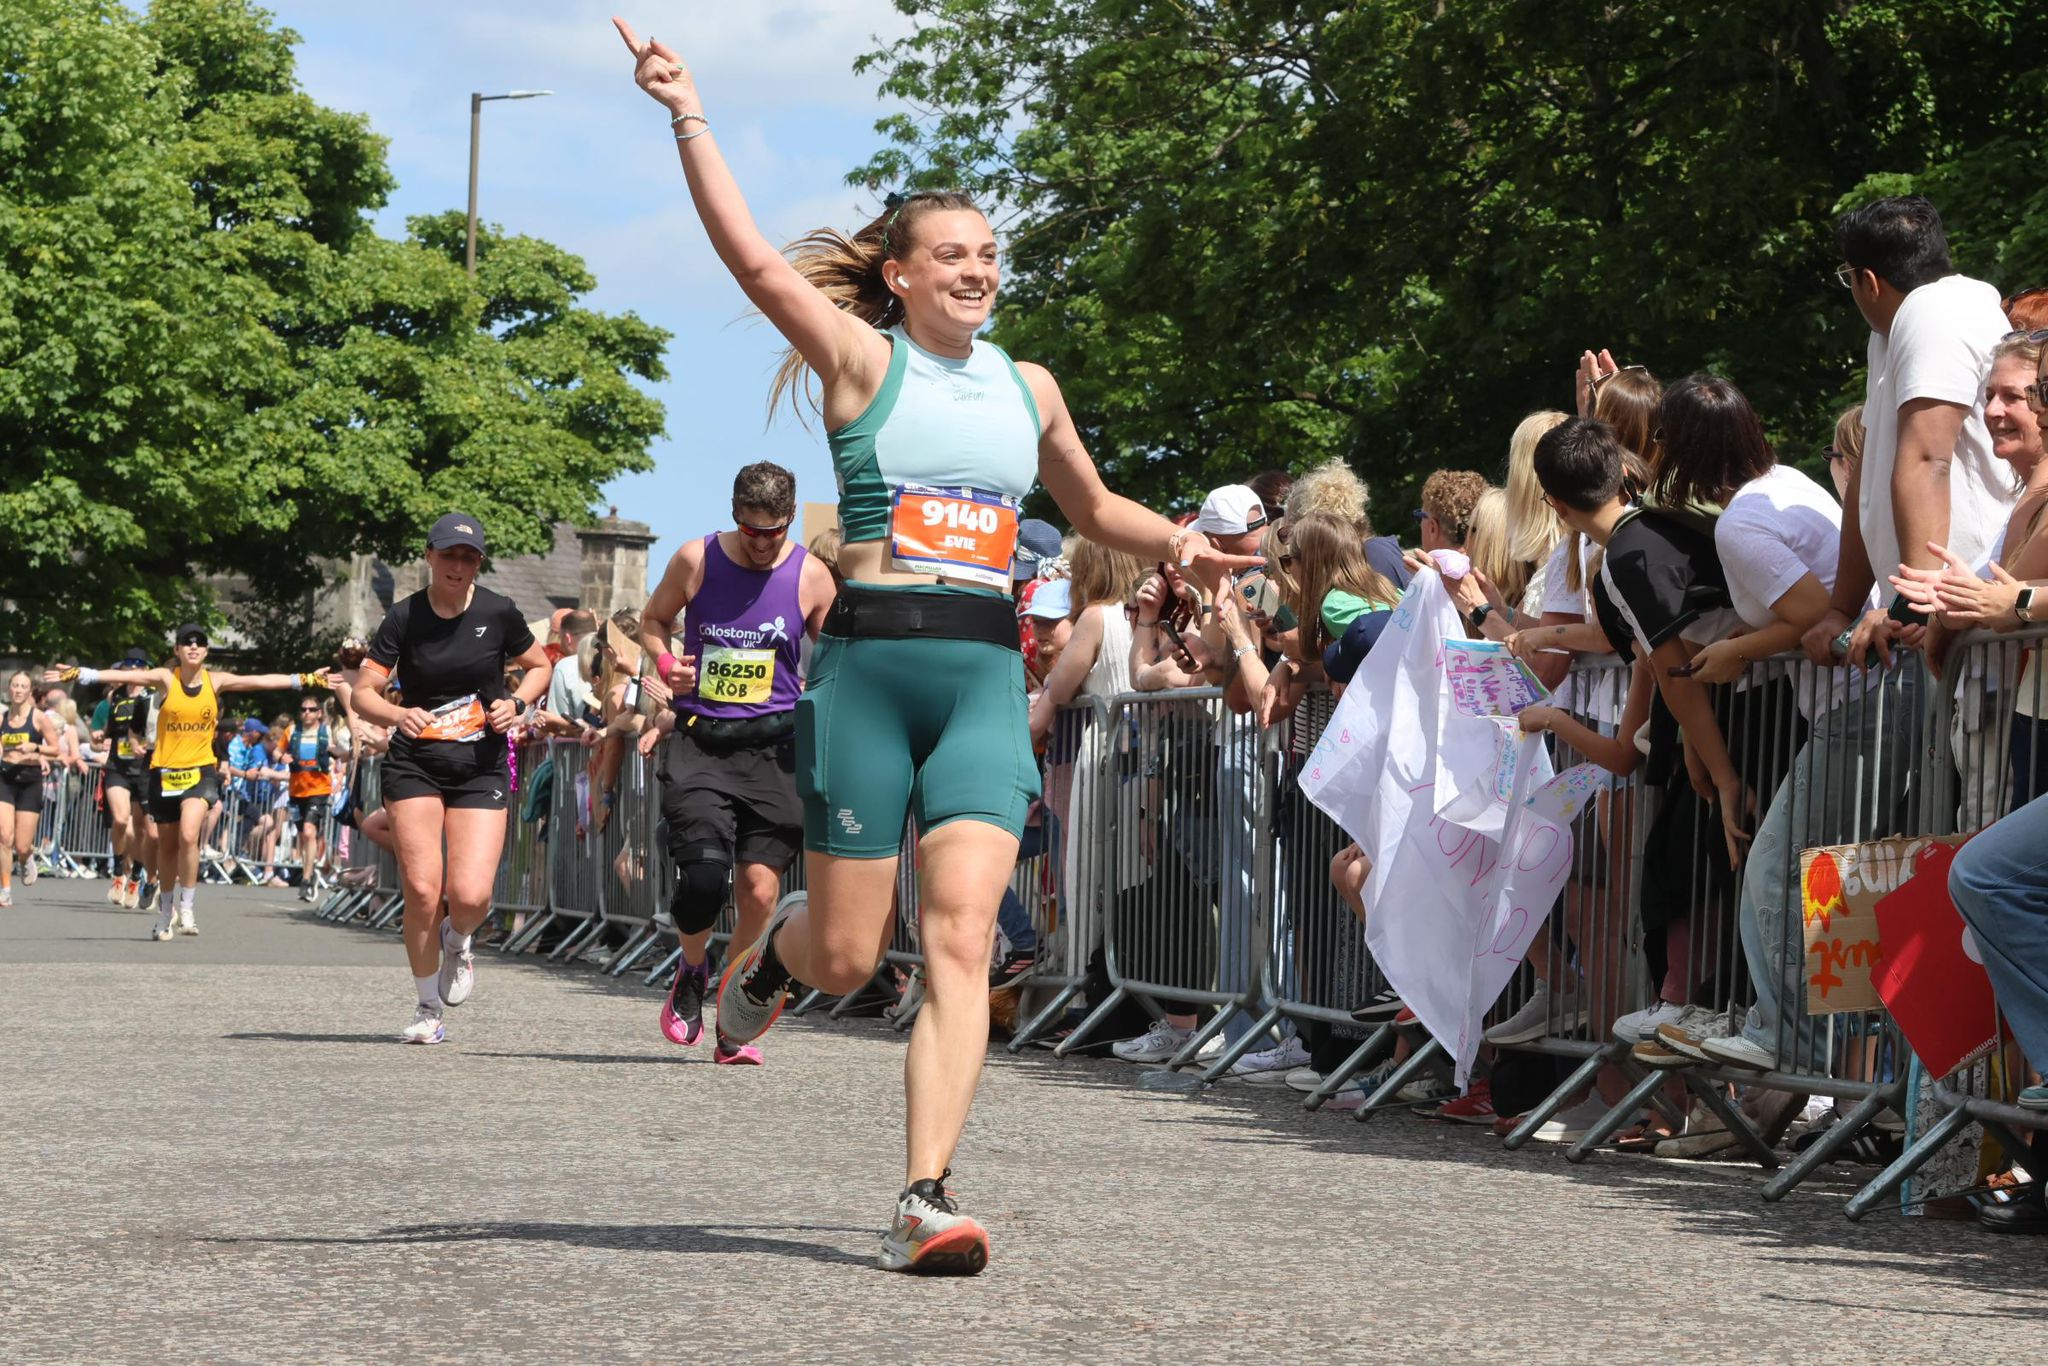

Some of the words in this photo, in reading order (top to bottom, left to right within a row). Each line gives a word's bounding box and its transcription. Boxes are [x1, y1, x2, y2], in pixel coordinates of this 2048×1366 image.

[921, 499, 998, 535] 9140
[944, 534, 976, 551] EVIE
[699, 624, 766, 644] Colostomy
[742, 640, 756, 648] UK
[707, 661, 767, 679] 86250
[715, 680, 748, 698] ROB
